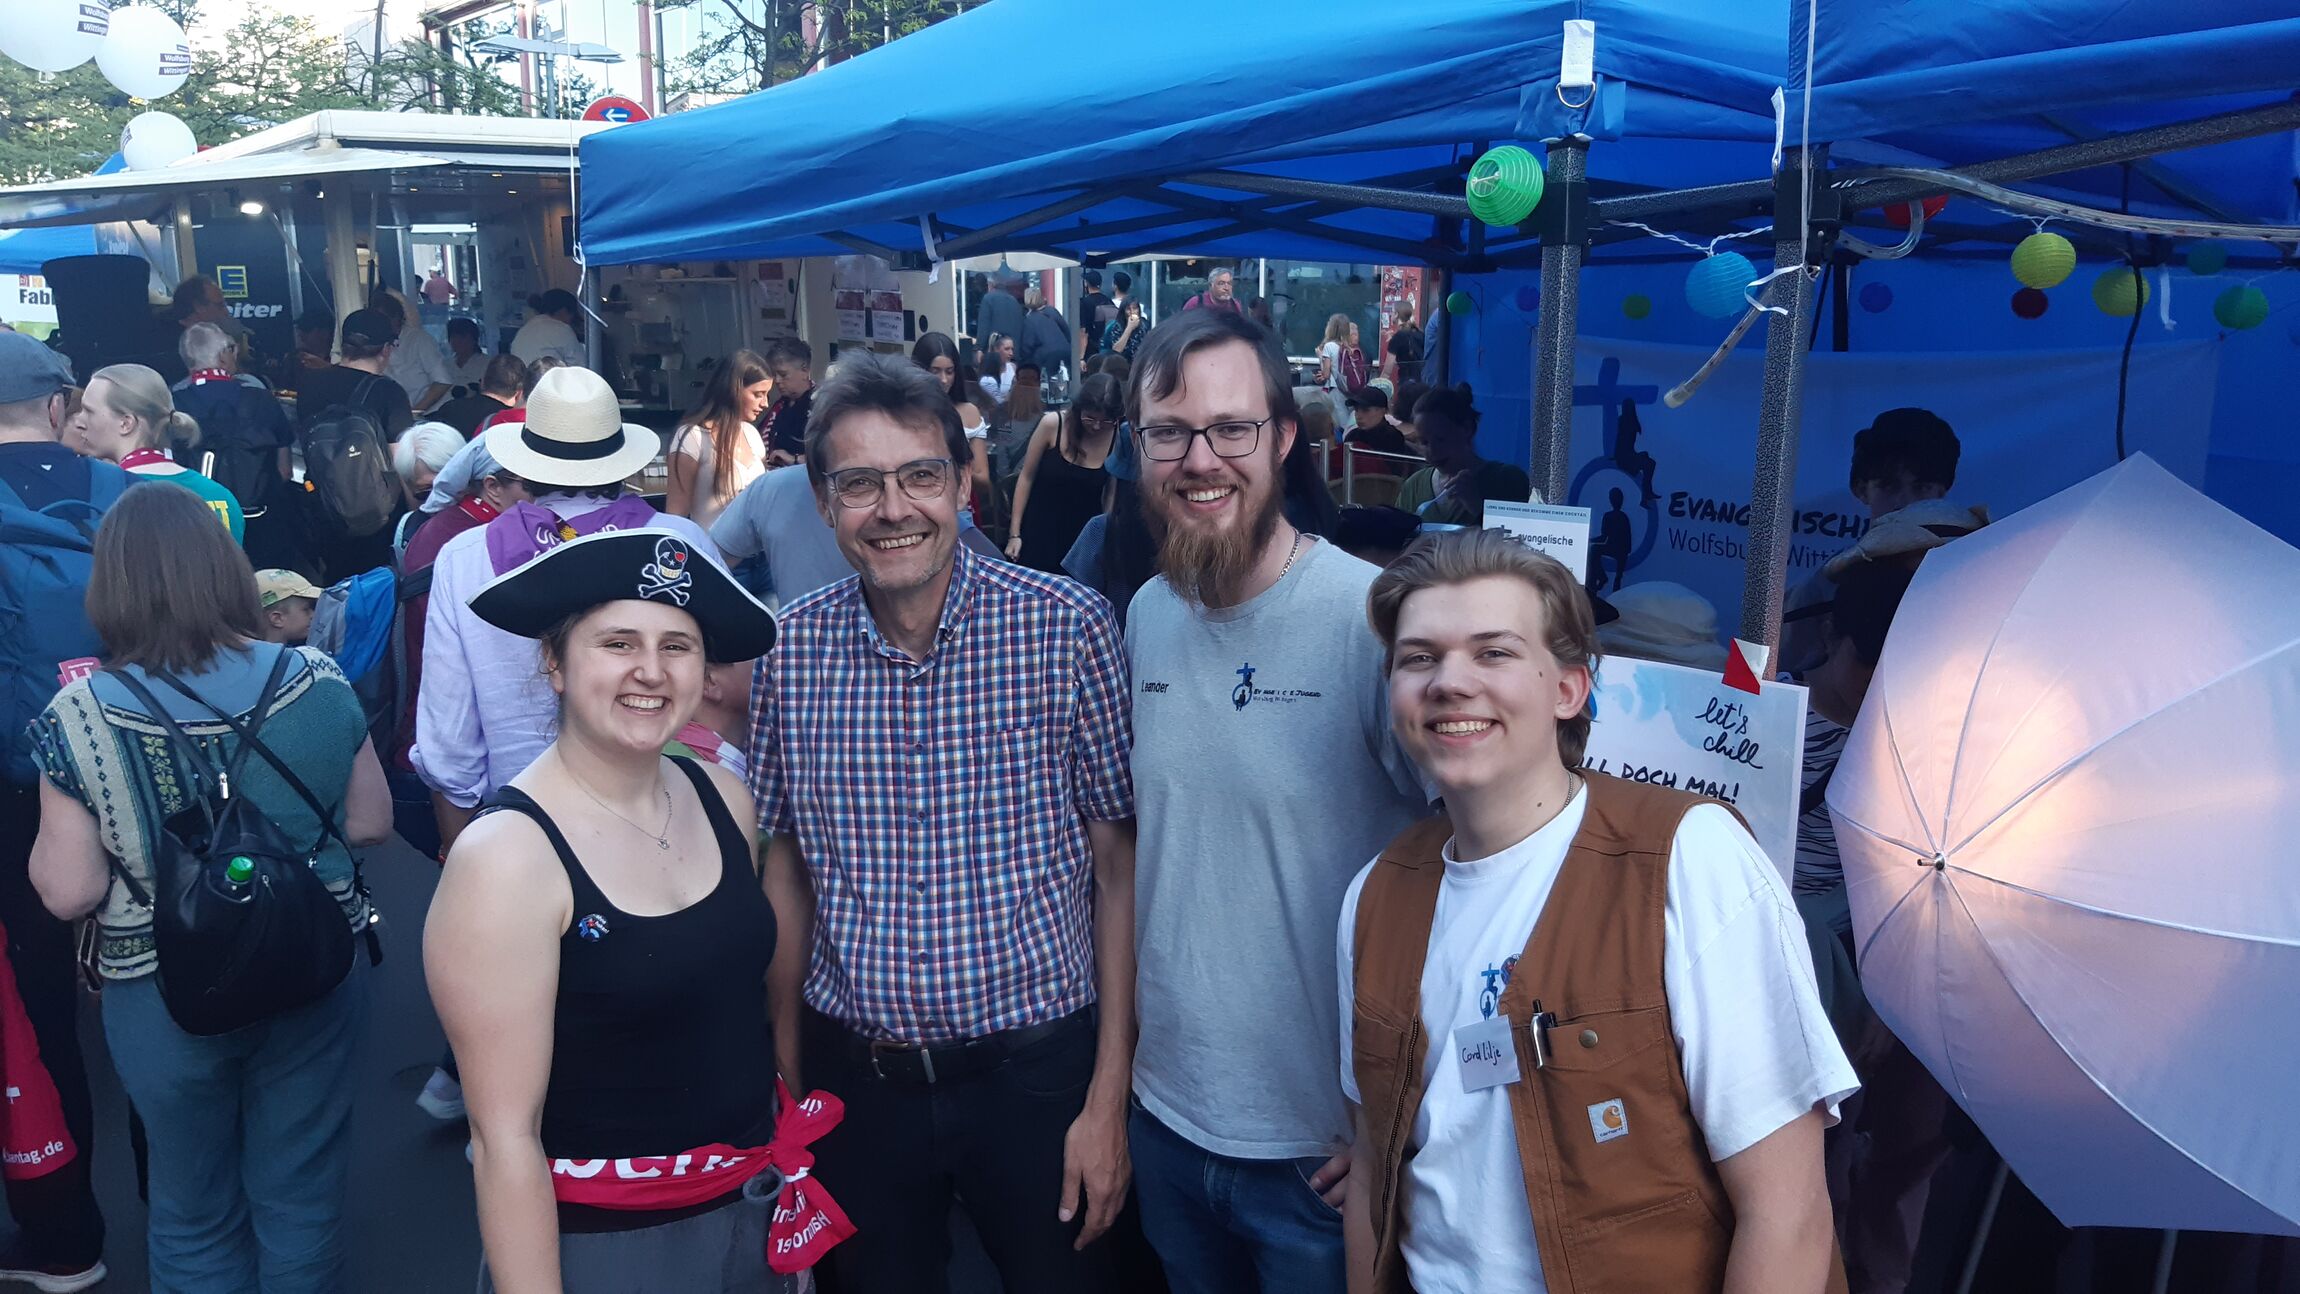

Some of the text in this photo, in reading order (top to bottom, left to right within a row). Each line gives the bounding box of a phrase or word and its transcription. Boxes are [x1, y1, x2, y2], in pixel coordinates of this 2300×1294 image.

[1668, 527, 1745, 560] Wolfsbu
[1695, 696, 1749, 735] let's
[1703, 731, 1764, 770] chill
[1621, 762, 1677, 788] DOCH
[1684, 776, 1740, 805] MAL!
